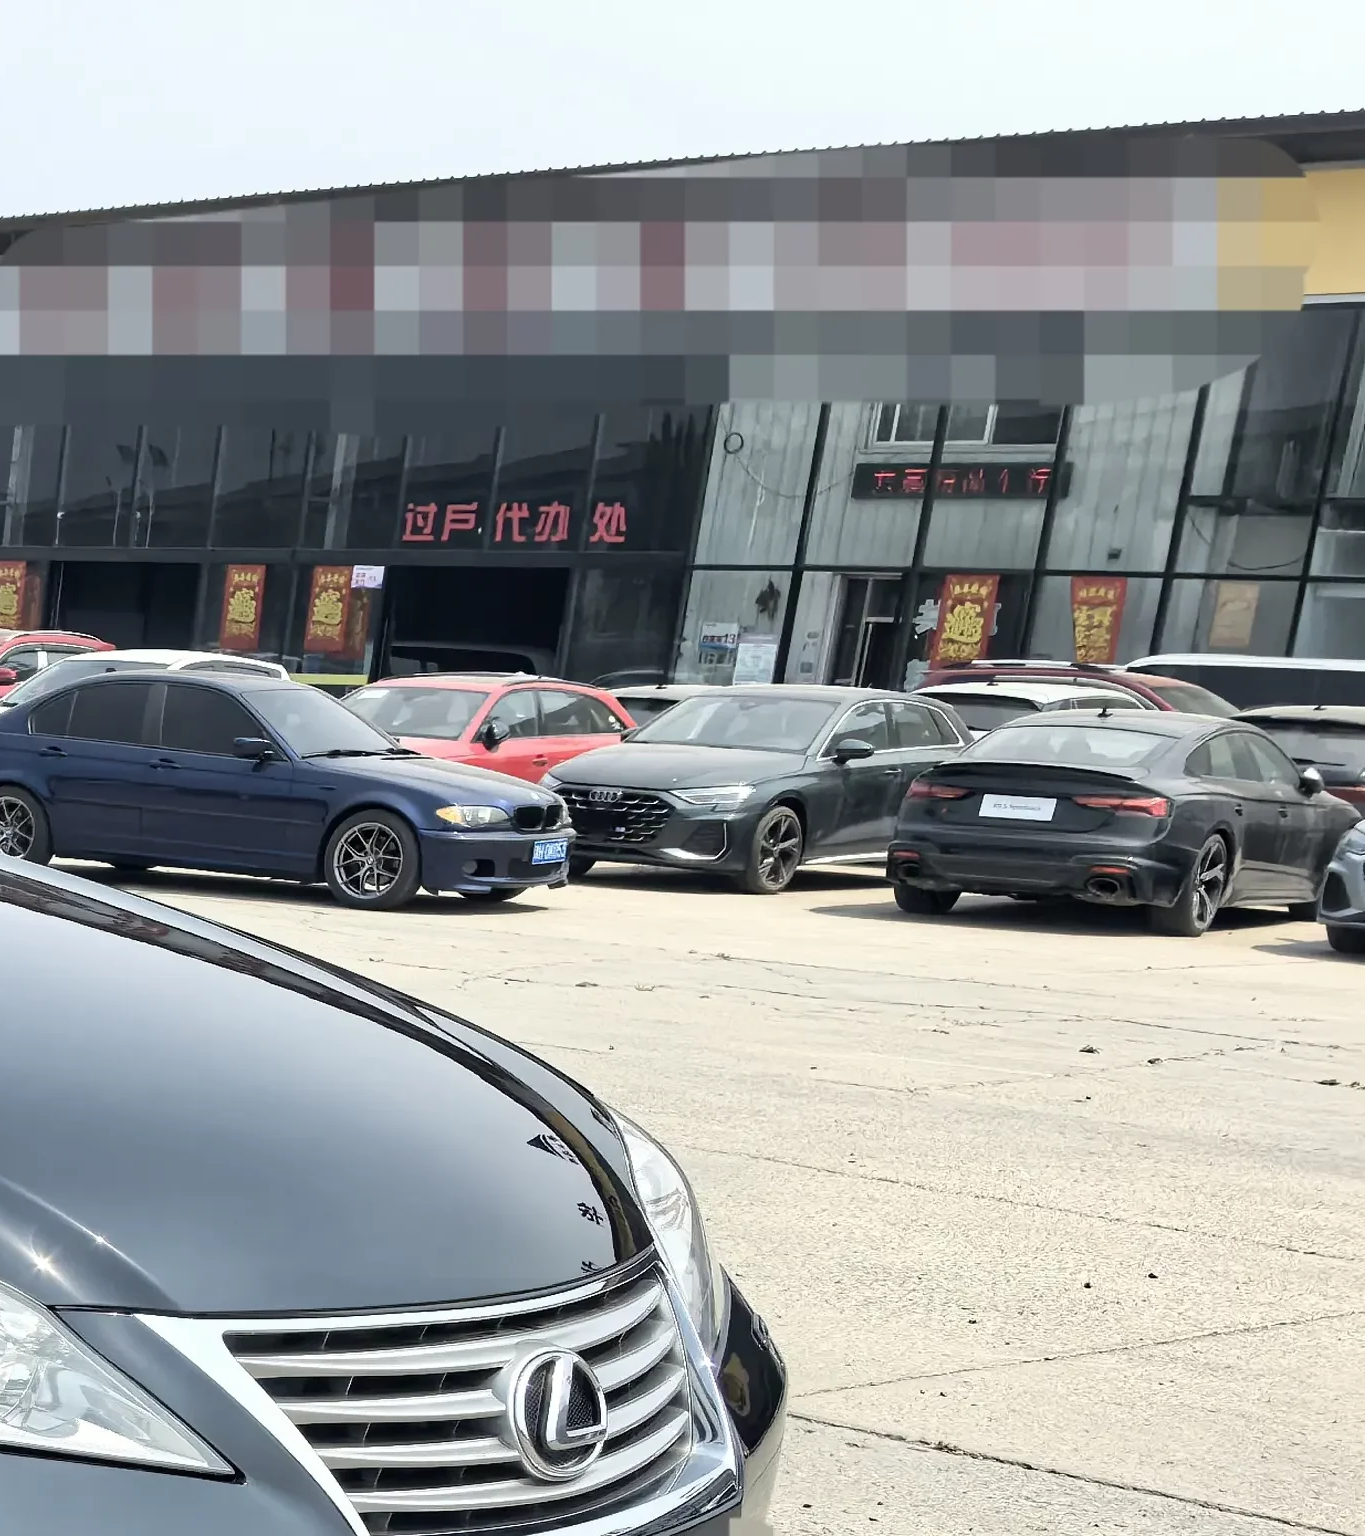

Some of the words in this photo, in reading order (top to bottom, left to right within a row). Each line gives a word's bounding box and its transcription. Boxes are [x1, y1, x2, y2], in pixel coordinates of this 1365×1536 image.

[401, 501, 627, 542] 过户代办处
